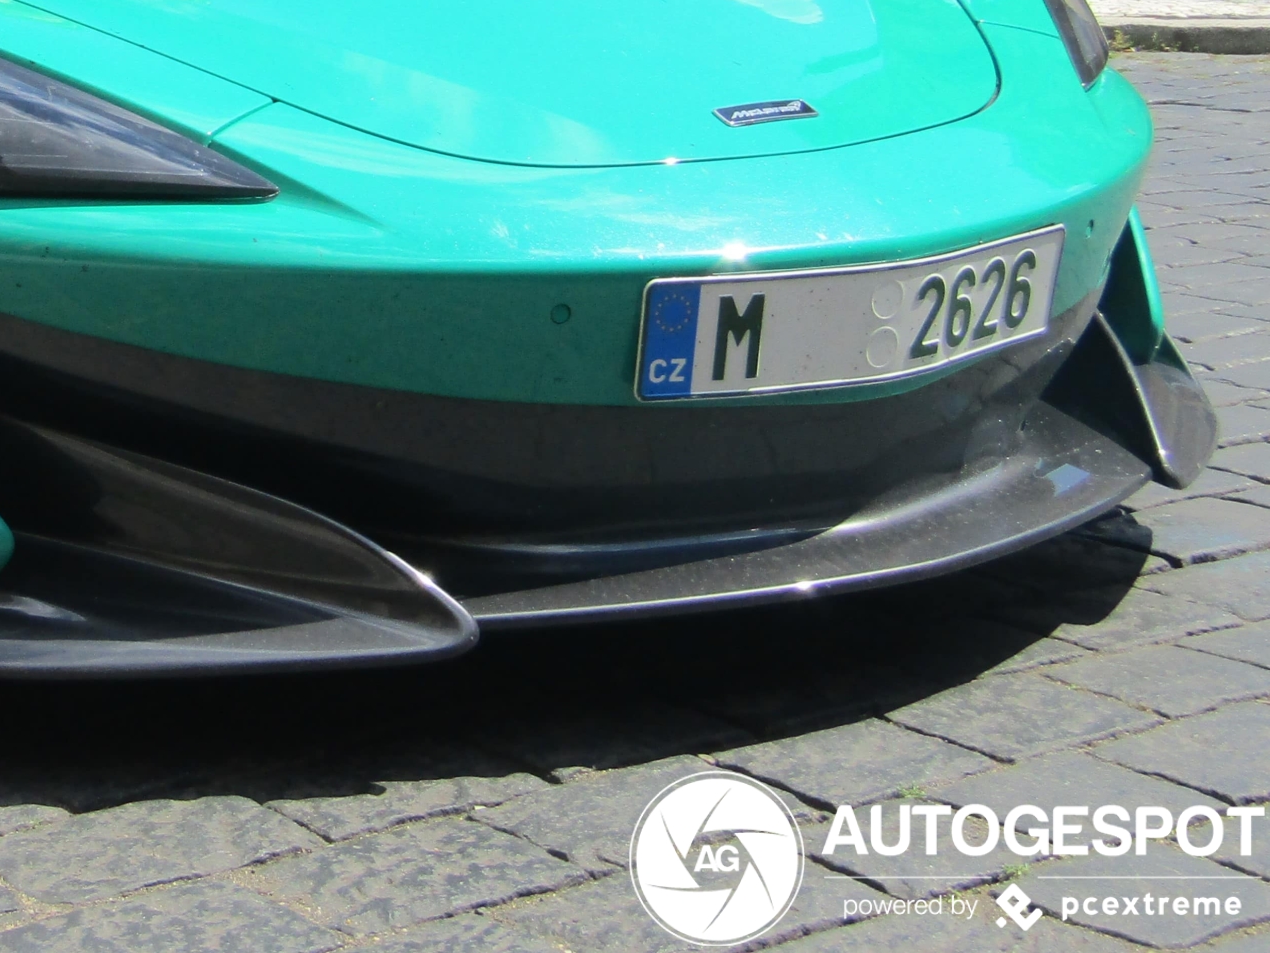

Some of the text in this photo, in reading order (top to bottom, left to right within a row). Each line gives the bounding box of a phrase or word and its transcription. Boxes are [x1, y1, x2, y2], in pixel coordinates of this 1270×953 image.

[712, 248, 1037, 382] M 2626
[648, 358, 687, 384] CZ
